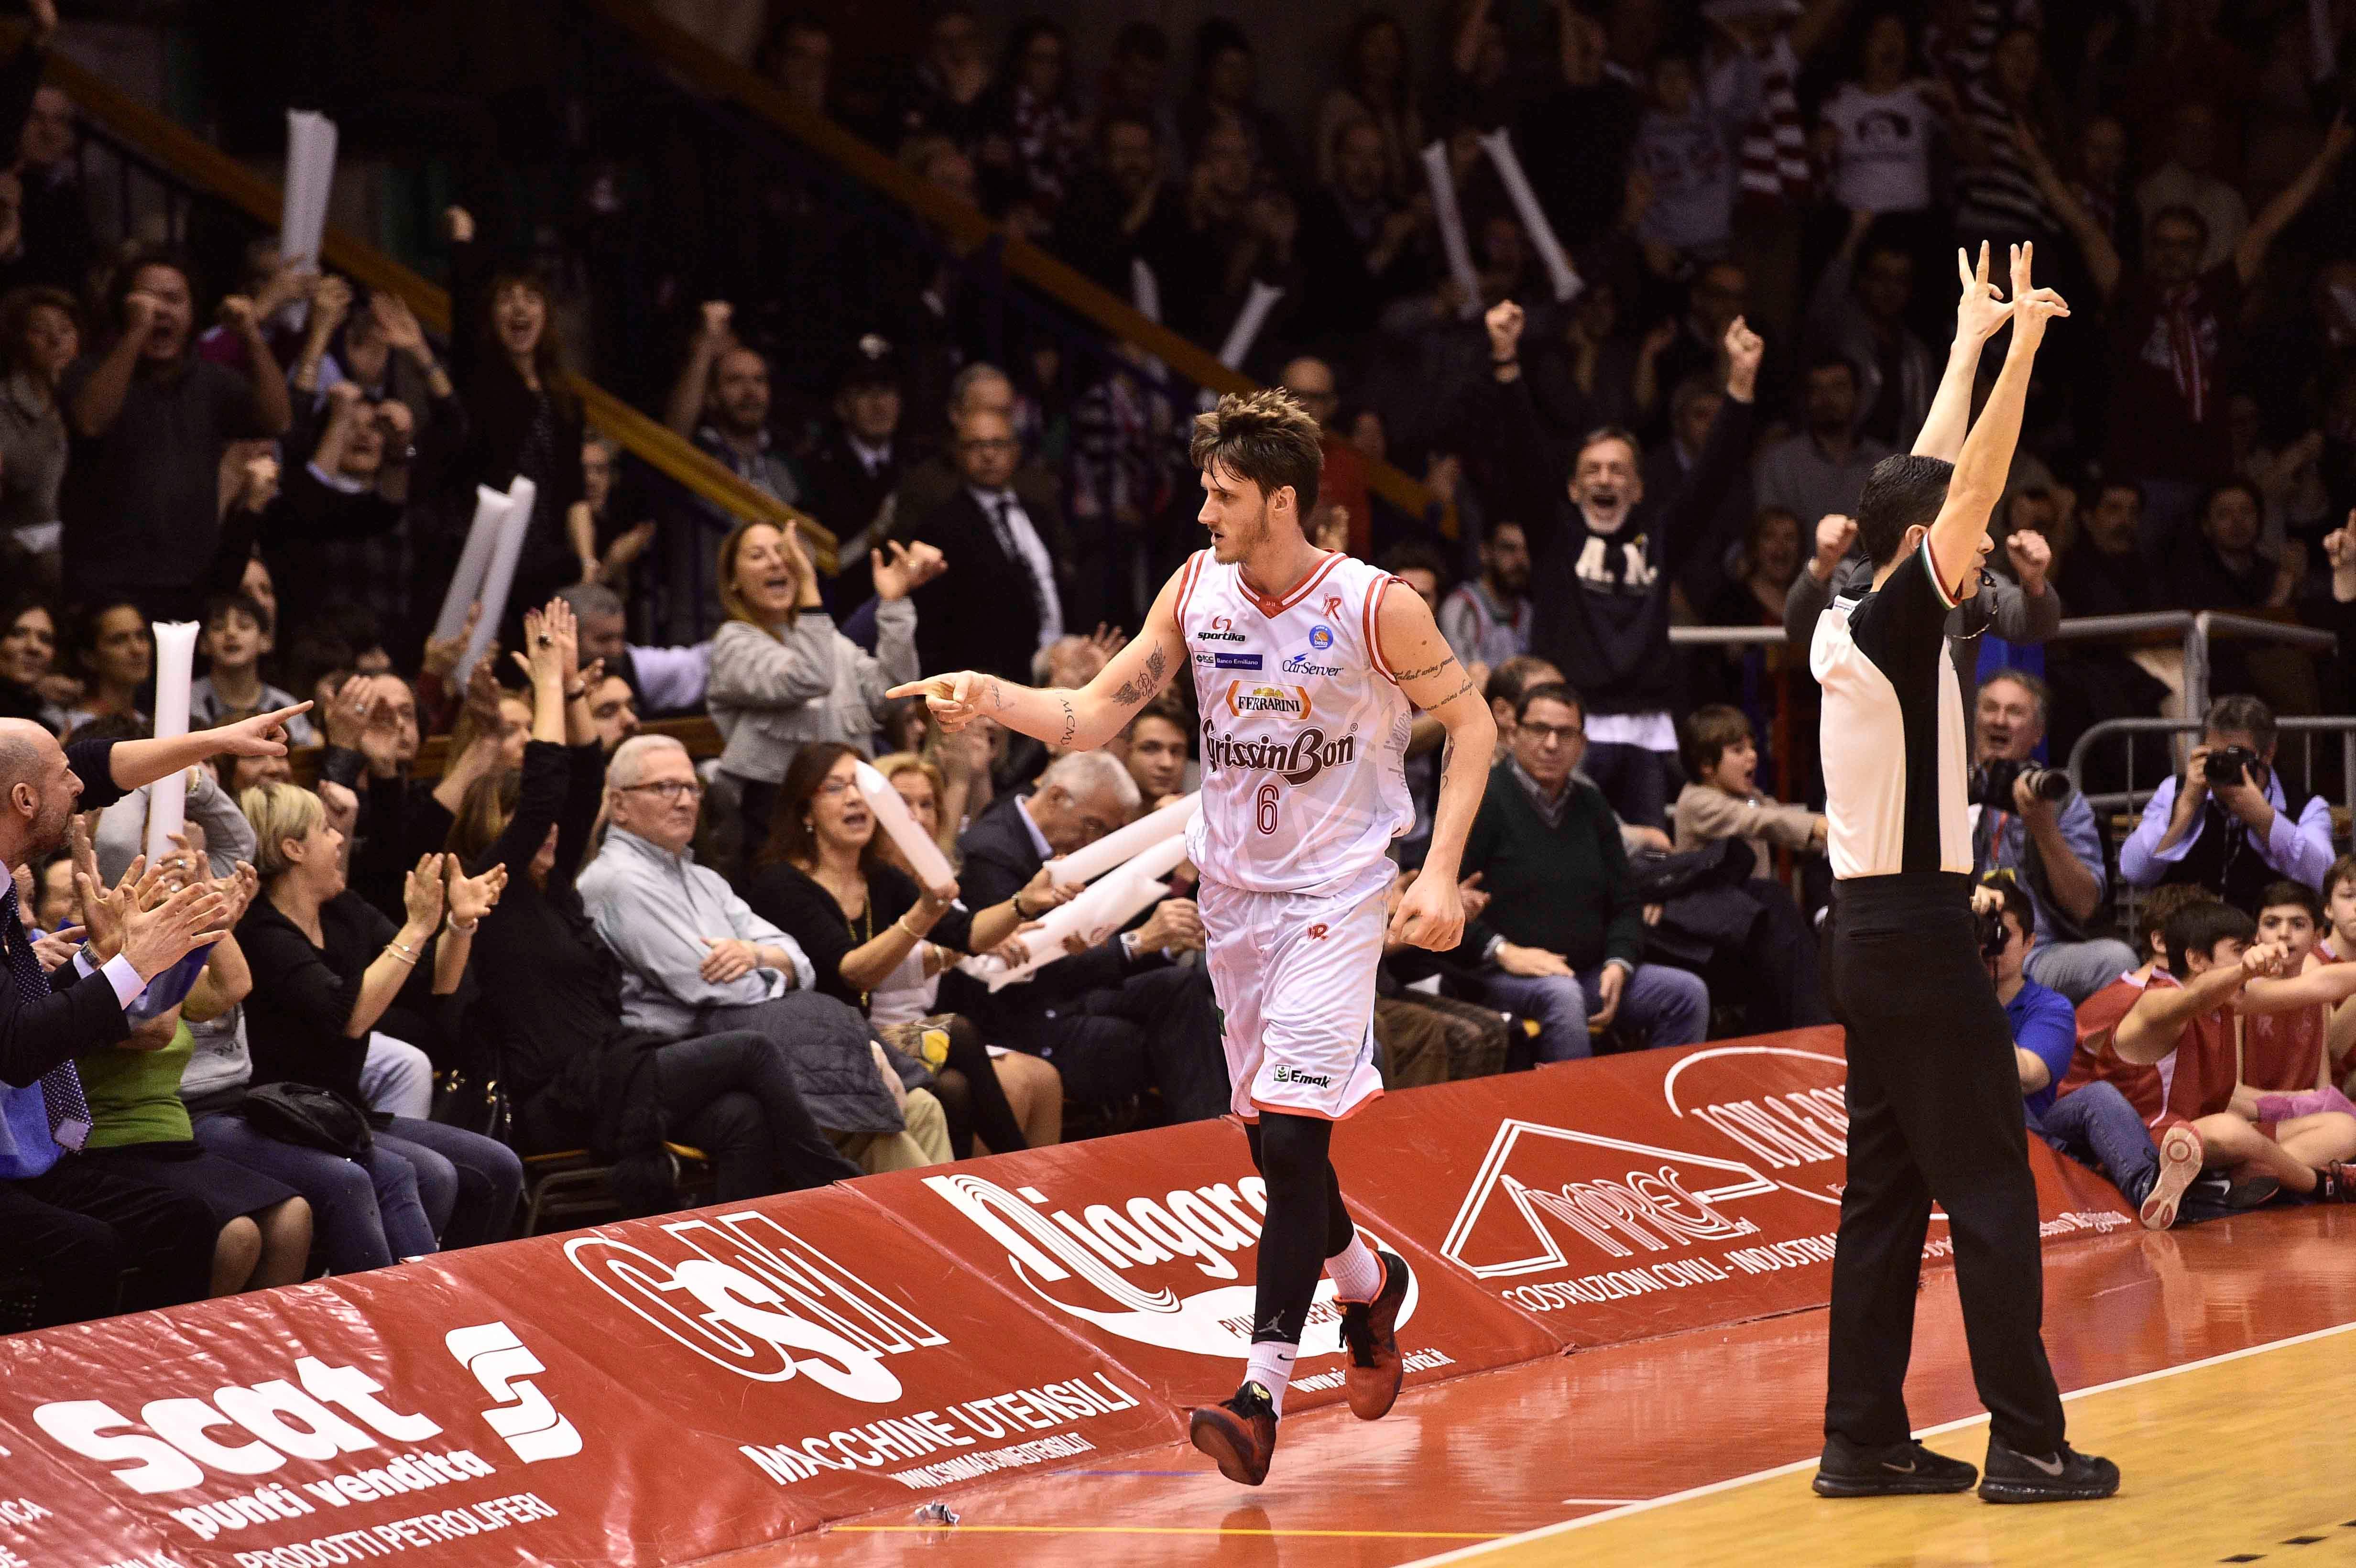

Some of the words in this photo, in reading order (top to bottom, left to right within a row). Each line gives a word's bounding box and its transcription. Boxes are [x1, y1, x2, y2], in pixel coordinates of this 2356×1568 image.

[1197, 632, 1246, 642] sportika
[1282, 659, 1342, 676] CarServer
[1238, 696, 1301, 712] FERRARINI
[1257, 784, 1279, 835] 6
[1291, 1070, 1330, 1089] Emak
[1502, 1266, 1668, 1312] COSTRUZIONI
[1659, 1257, 1730, 1288] CIVILI
[33, 1356, 444, 1494] scat
[738, 1410, 976, 1486] MACCHINE
[946, 1371, 1140, 1439] UTENSILI
[168, 1481, 316, 1542] punti
[302, 1449, 497, 1507] vendita
[233, 1525, 391, 1568] PRODOTTI
[371, 1492, 559, 1551] PETROLIFERI
